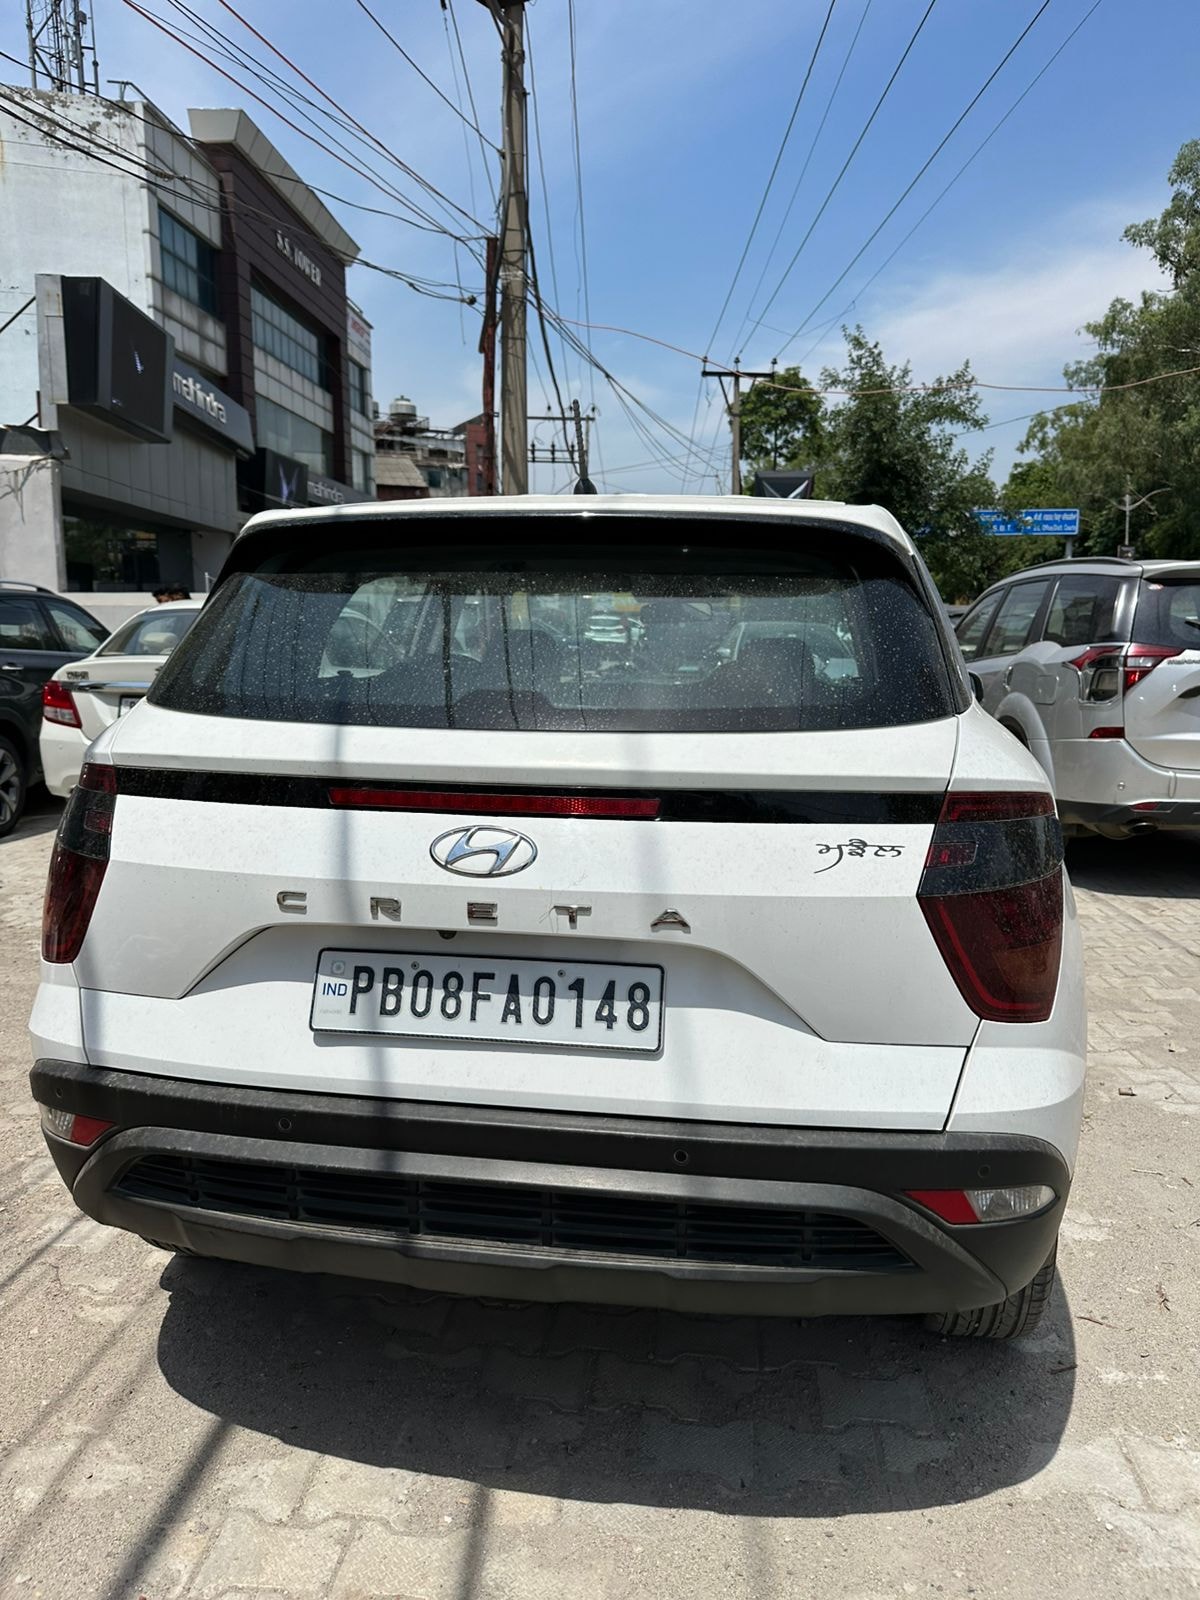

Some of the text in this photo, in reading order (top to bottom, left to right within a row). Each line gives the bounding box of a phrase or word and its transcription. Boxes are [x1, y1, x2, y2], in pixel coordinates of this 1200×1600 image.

[173, 372, 226, 424] mahindra
[276, 890, 692, 934] CRETA
[322, 982, 347, 996] IND
[349, 965, 651, 1032] PB08FA0148
